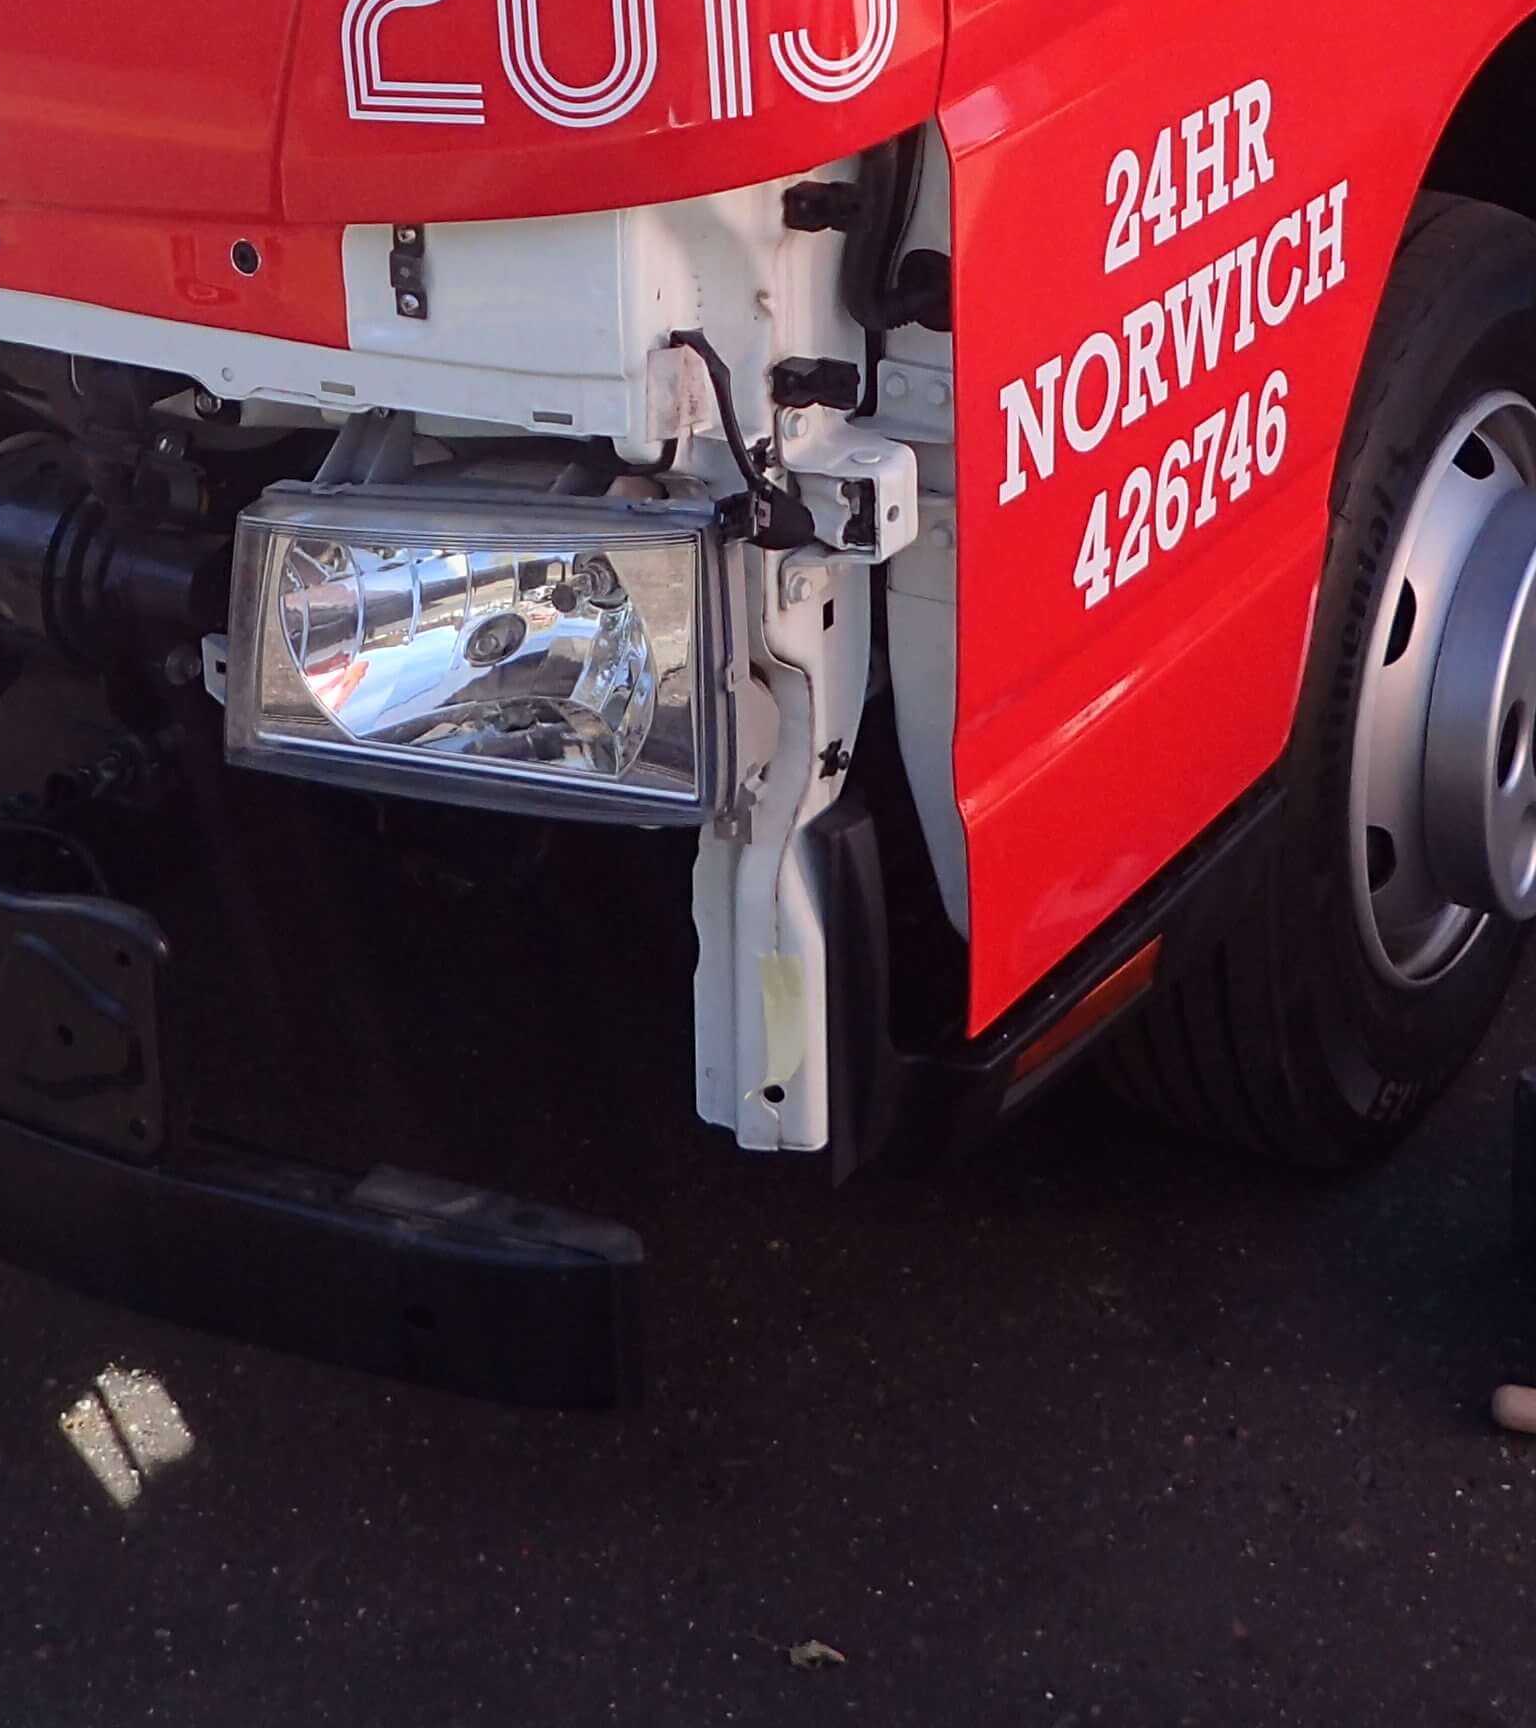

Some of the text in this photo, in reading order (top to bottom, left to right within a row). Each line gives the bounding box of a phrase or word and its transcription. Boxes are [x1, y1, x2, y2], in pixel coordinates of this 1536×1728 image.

[1104, 79, 1275, 274] 24HR
[999, 180, 1348, 506] NORWICH
[1073, 370, 1289, 610] 426746
